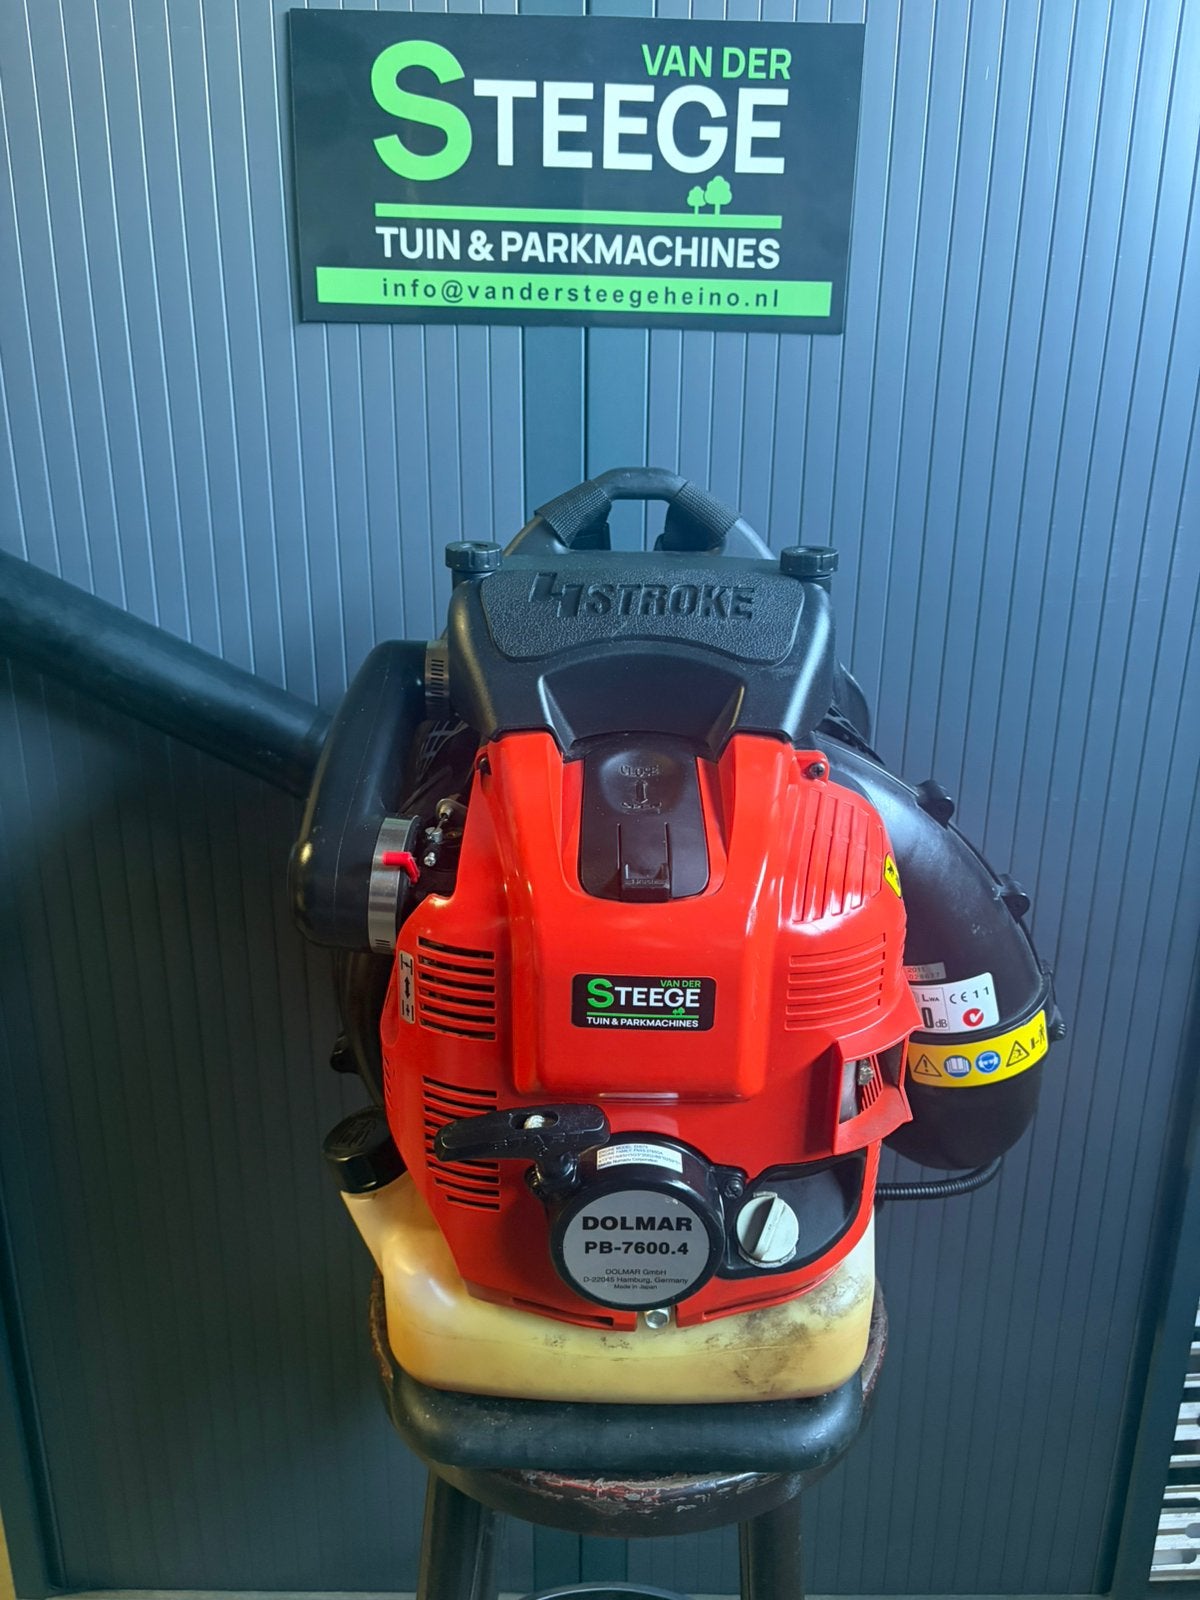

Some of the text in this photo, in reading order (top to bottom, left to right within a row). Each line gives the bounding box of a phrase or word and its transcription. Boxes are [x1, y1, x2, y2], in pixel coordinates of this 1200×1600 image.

[642, 44, 792, 81] VAN DER
[370, 39, 790, 182] STEEGE
[375, 226, 781, 271] TUIN & PARKMACHINES
[381, 277, 780, 309] info@vandersteegeheino.nl
[660, 979, 701, 988] VAN DER
[586, 978, 701, 1008] STEEGE
[586, 1016, 699, 1028] TUIN & PARKMACHINES
[935, 1018, 948, 1029] dB
[582, 1216, 692, 1232] DOLMAR
[584, 1241, 689, 1256] PB-7600.4
[605, 1268, 667, 1276] DOLMAR GmbH
[616, 1276, 653, 1285] Hamburg,
[654, 1276, 688, 1285] Germany
[639, 1283, 658, 1291] Japan
